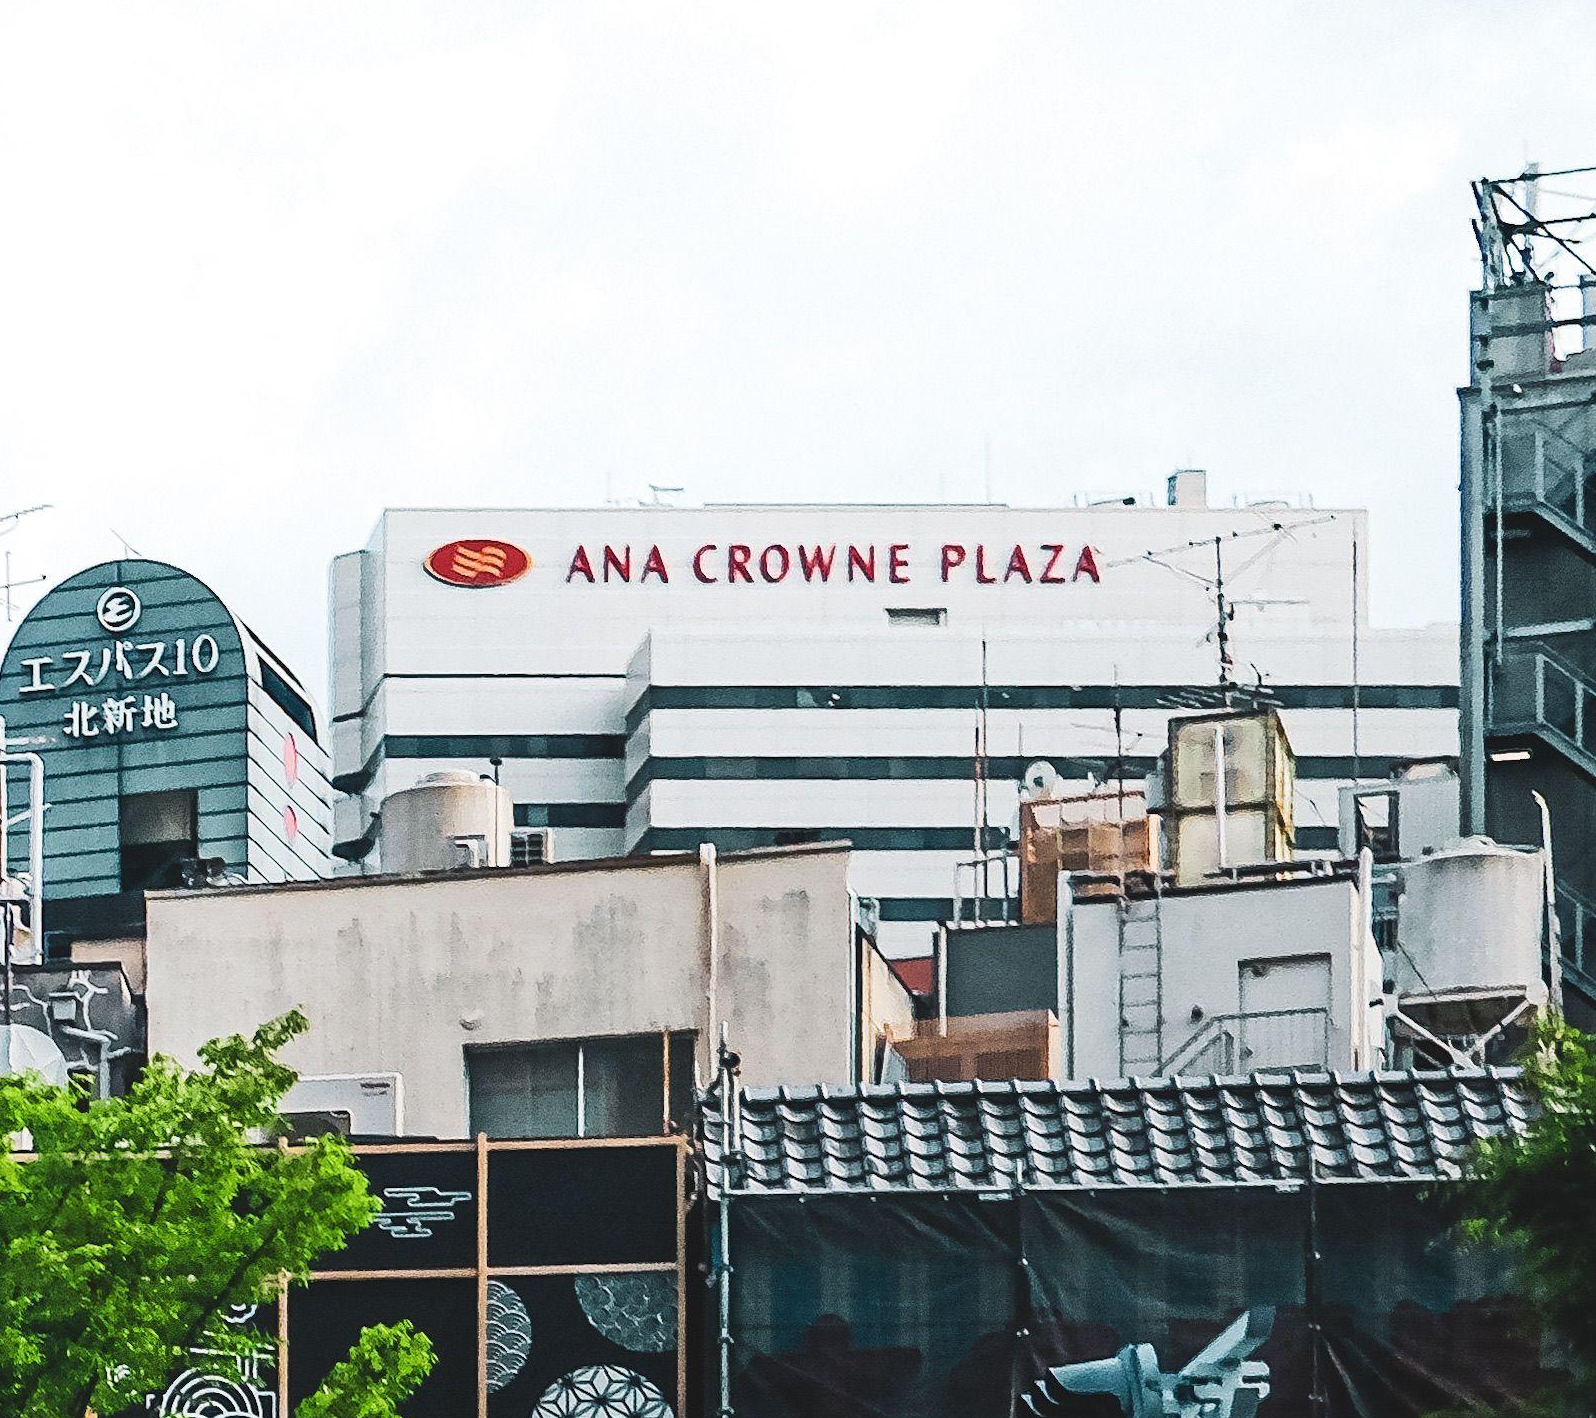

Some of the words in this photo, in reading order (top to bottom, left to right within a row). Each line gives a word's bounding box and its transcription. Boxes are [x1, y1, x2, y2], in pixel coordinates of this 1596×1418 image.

[565, 542, 670, 585] ANA
[691, 542, 912, 585] CROWNE
[940, 542, 1102, 585] PLAZA
[18, 633, 220, 694] エスパス10
[63, 692, 179, 739] 北新地
